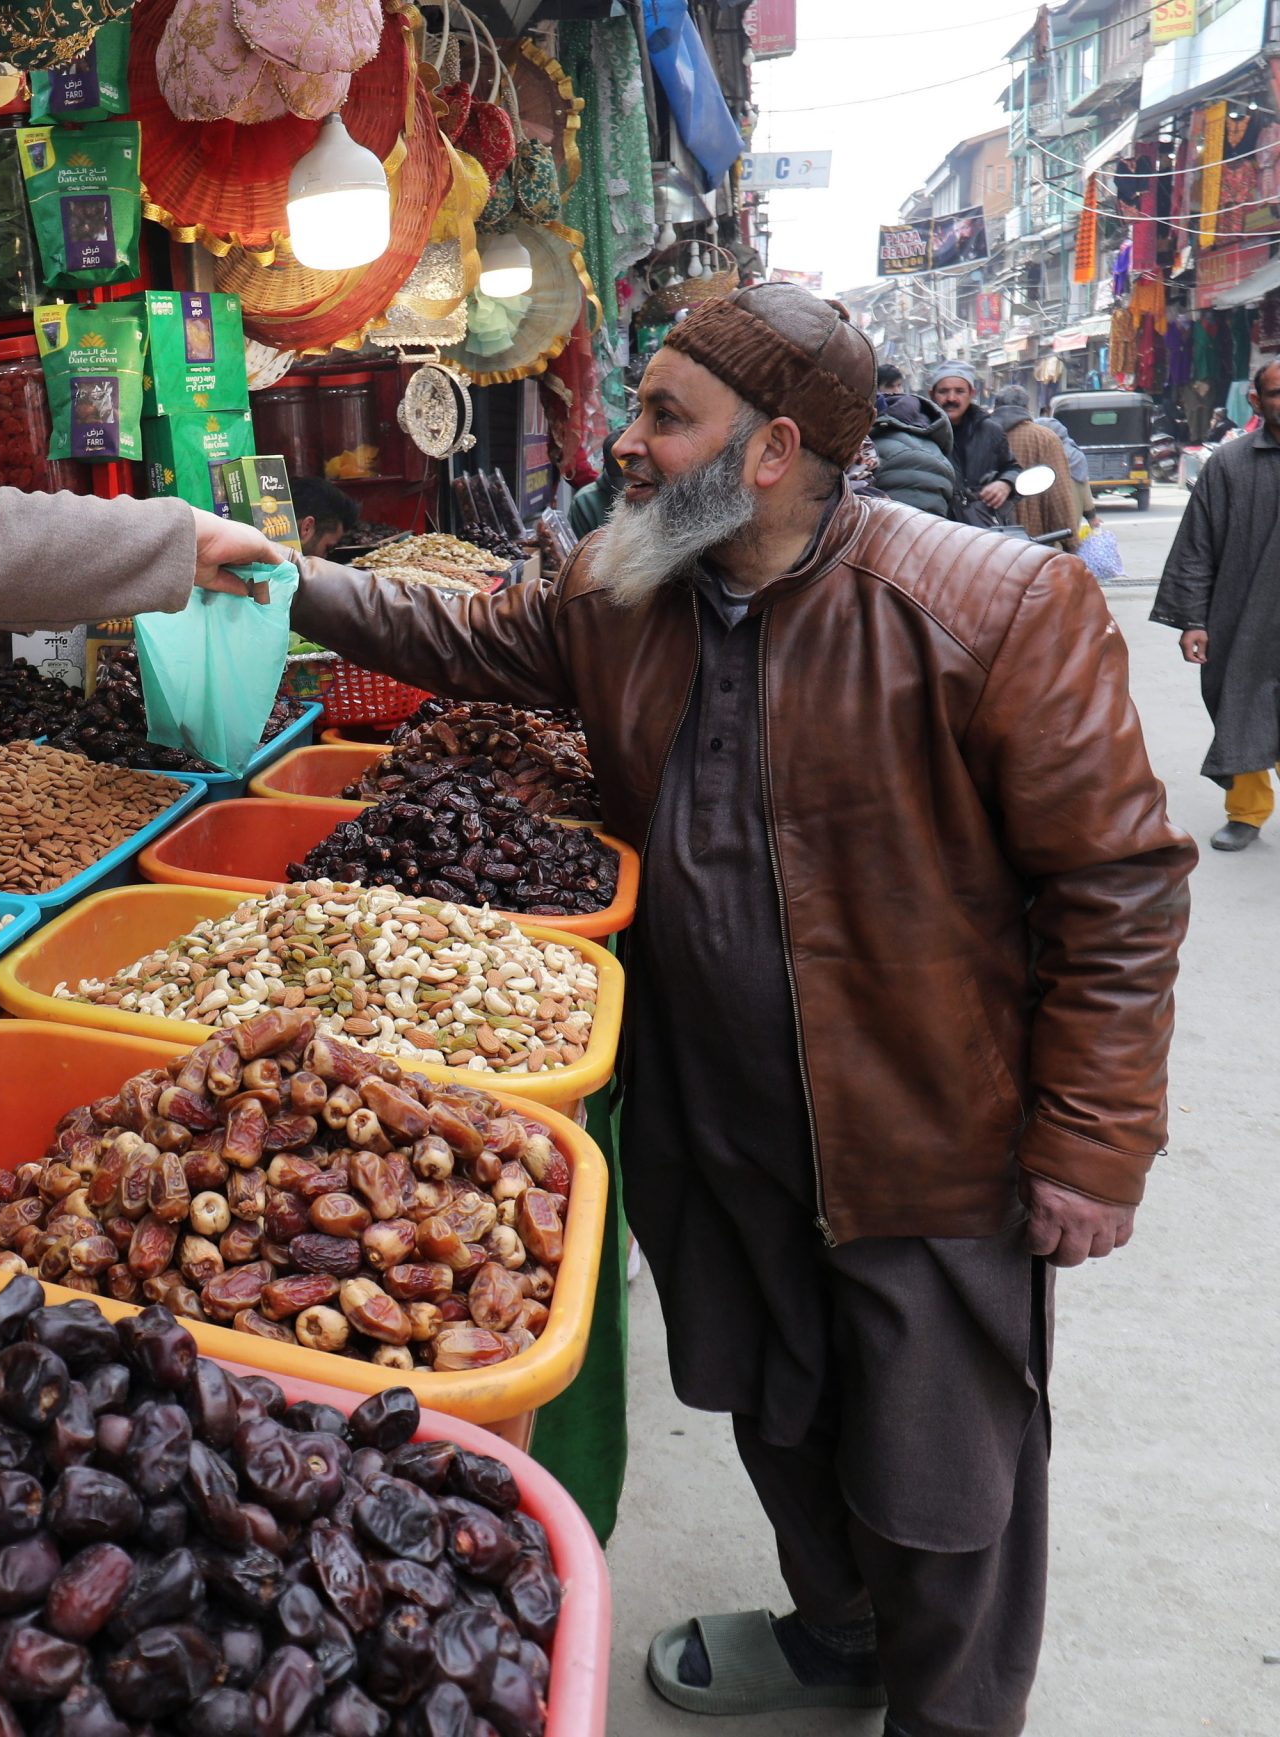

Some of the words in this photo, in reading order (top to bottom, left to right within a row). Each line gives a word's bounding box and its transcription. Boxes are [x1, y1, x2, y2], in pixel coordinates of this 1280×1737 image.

[65, 90, 83, 99] FARD
[57, 175, 78, 184] Date
[79, 174, 107, 182] Crown
[884, 230, 922, 246] PLAZA
[881, 241, 927, 260] BEAUTY
[82, 256, 100, 265] FARD
[68, 356, 88, 364] Date
[86, 438, 104, 446] FARD
